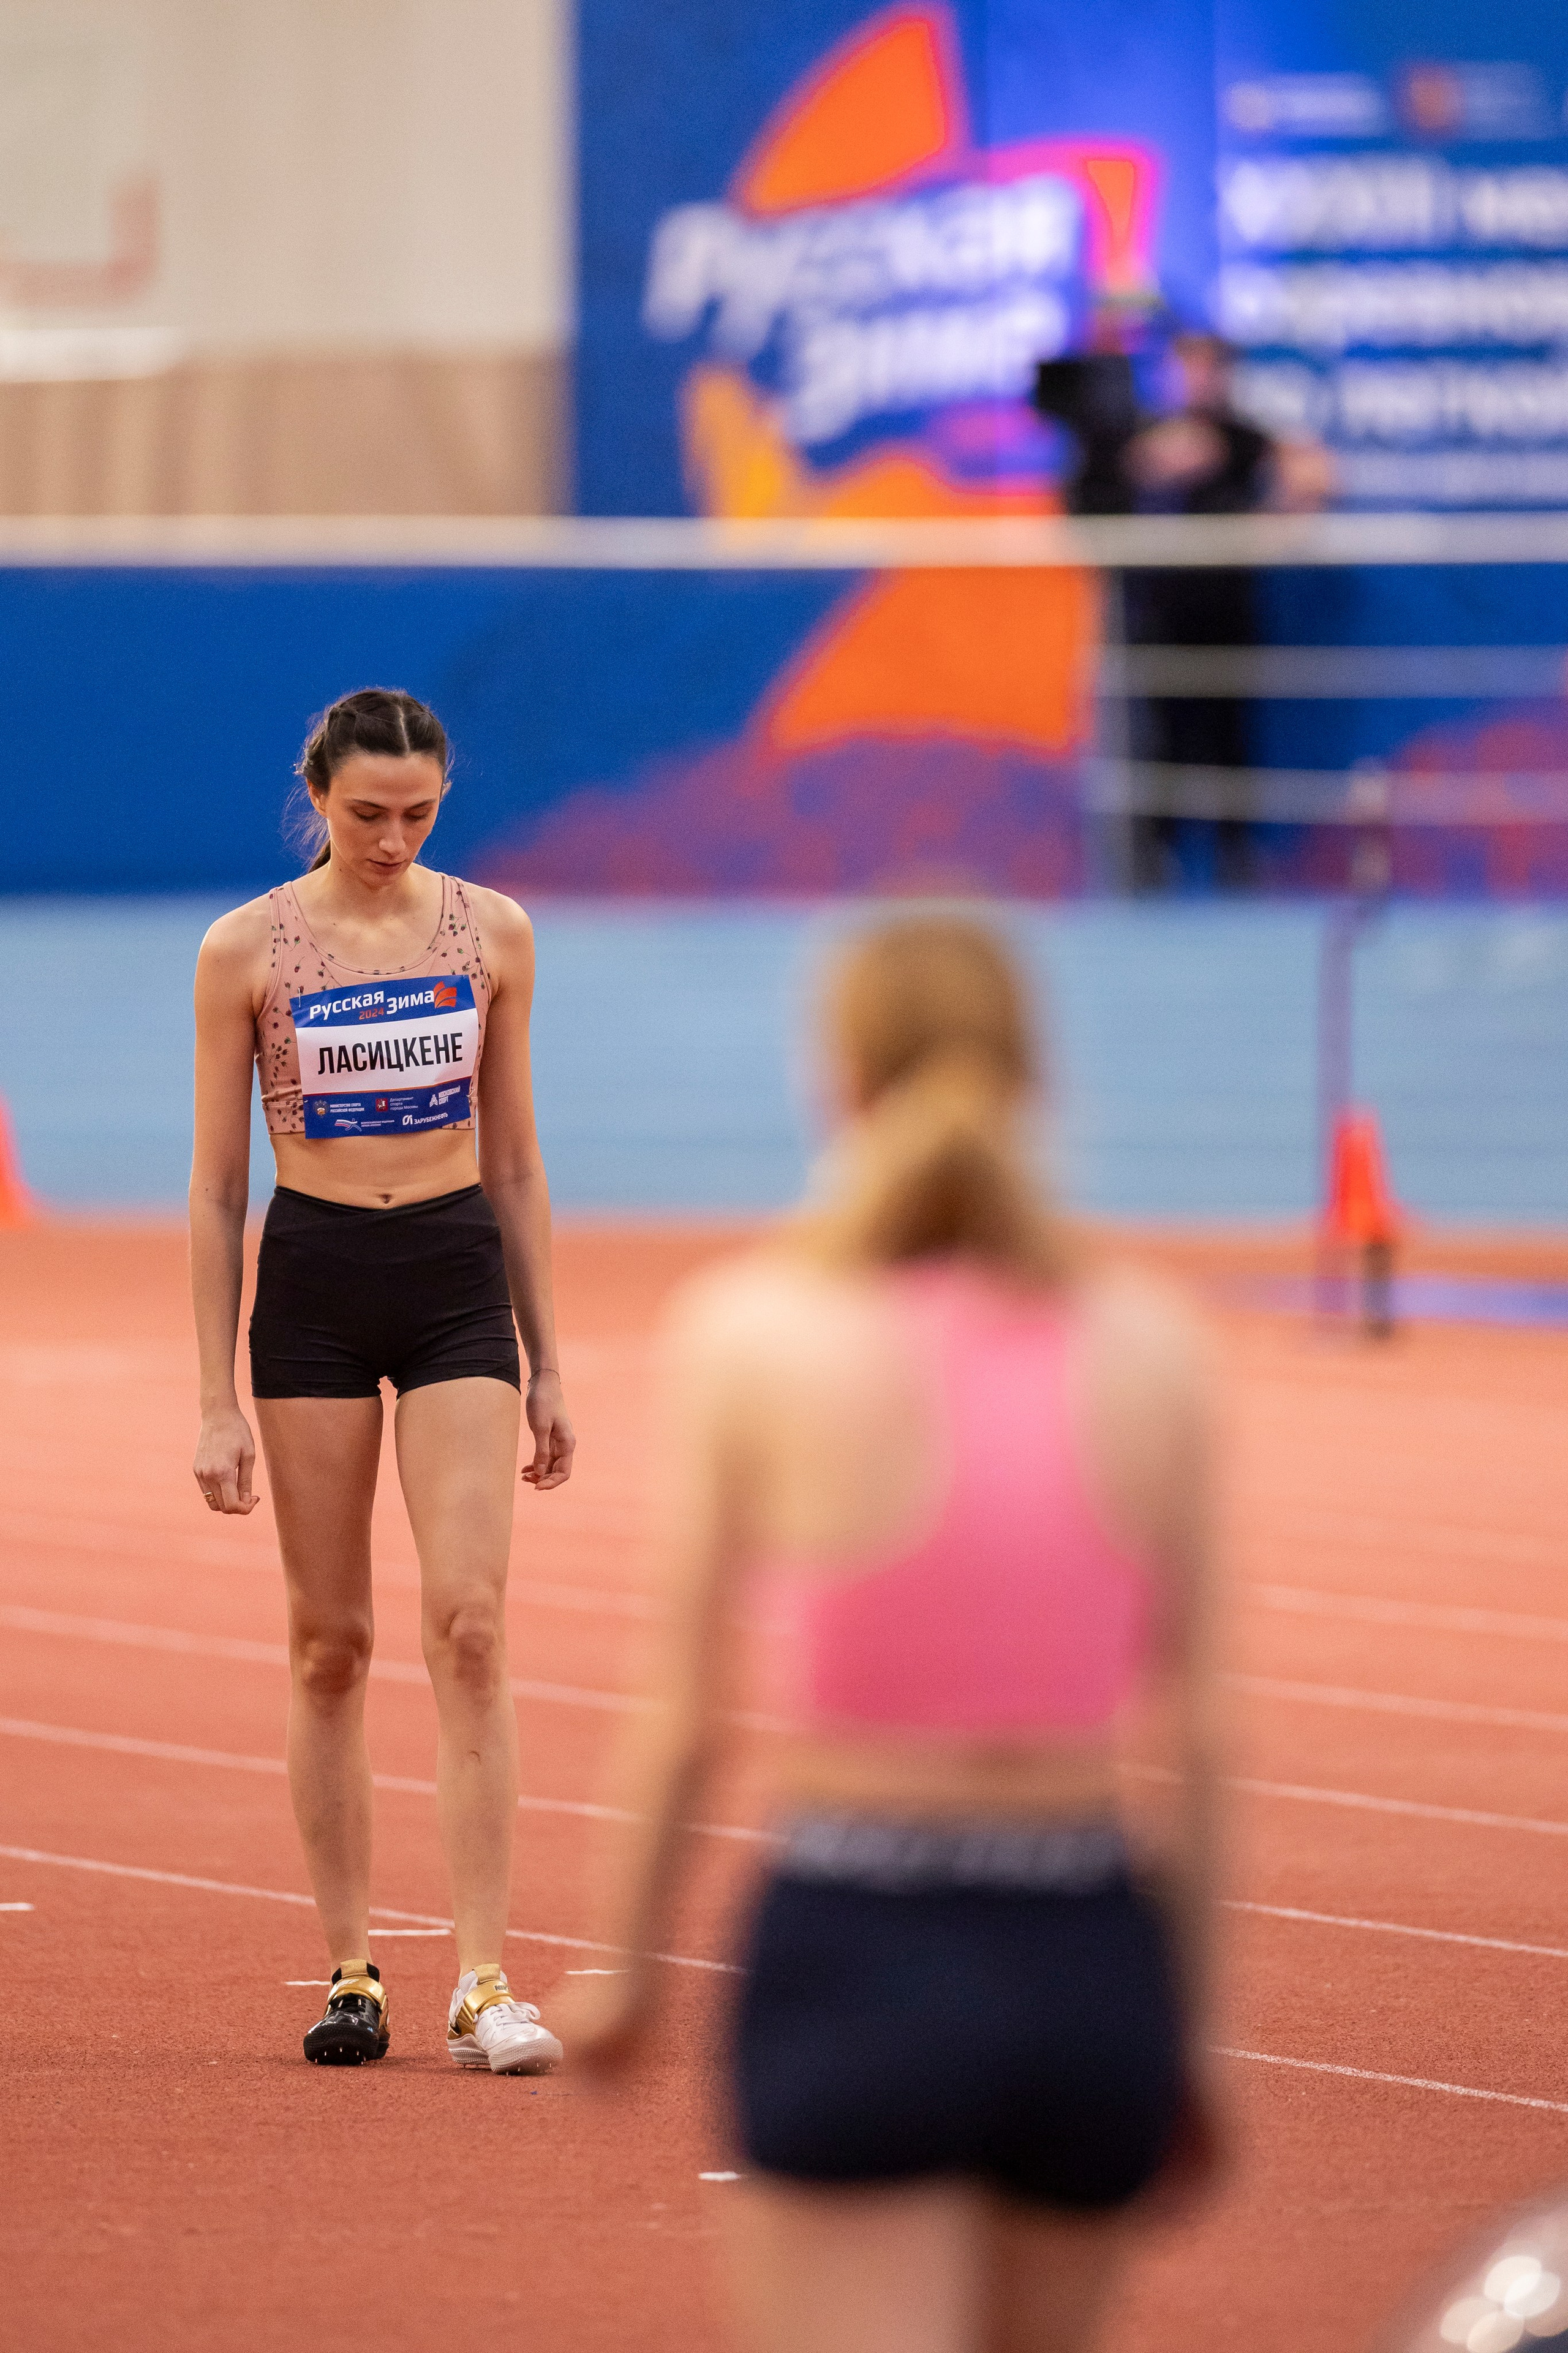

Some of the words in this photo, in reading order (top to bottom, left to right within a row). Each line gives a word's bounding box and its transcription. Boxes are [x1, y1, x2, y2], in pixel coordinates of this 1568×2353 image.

[309, 991, 384, 1020] Русская
[386, 990, 434, 1014] Зима
[359, 1008, 384, 1020] 2024
[318, 1032, 462, 1075] ЛАСИЦКЕНЕ
[413, 1112, 448, 1125] ЗАРУБЕЖНЕФТЬ
